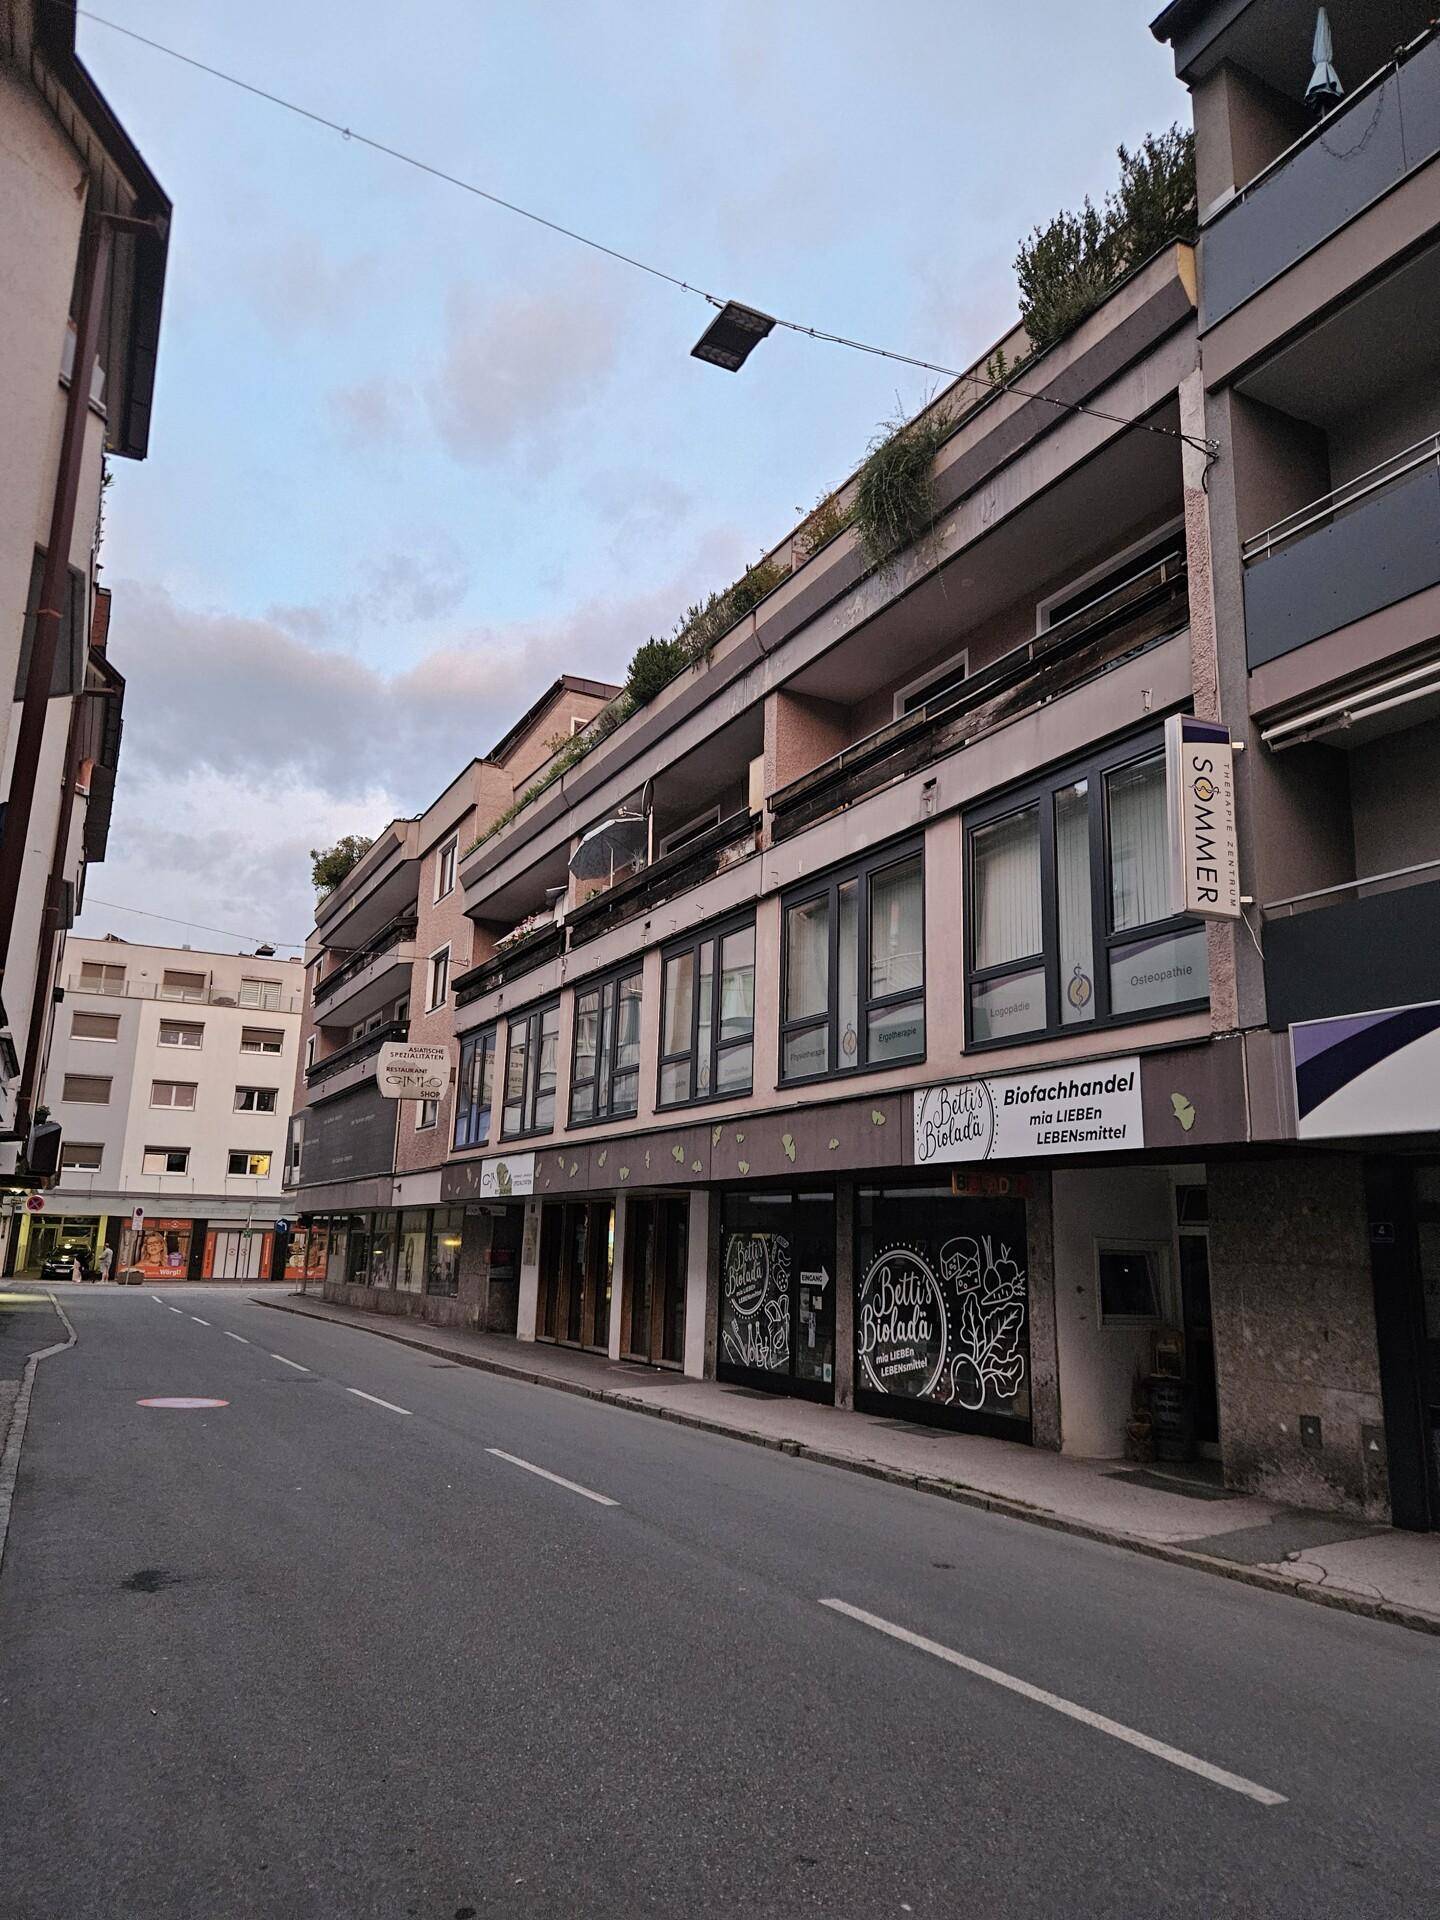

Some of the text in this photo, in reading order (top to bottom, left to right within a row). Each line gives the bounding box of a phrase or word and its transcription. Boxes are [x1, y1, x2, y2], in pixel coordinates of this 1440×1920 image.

[1189, 756, 1219, 903] SOMMER
[1223, 763, 1237, 907] THERAPIE ZENTRUM
[1130, 965, 1193, 986] Osteopathie
[990, 1002, 1030, 1018] Logopädie
[878, 1026, 917, 1043] Ergotherapie
[1004, 1072, 1135, 1105] Biofachhandel
[933, 1087, 984, 1128] Betti's
[1029, 1107, 1102, 1126] mia LIEBEn
[918, 1111, 984, 1161] Bioladä
[1036, 1125, 1126, 1145] LEBENsmittel
[801, 1274, 823, 1282] EINGANG
[873, 1266, 932, 1317] Betti's
[875, 1347, 915, 1365] mia LIEBEn
[880, 1357, 928, 1377] LEBENsmittel
